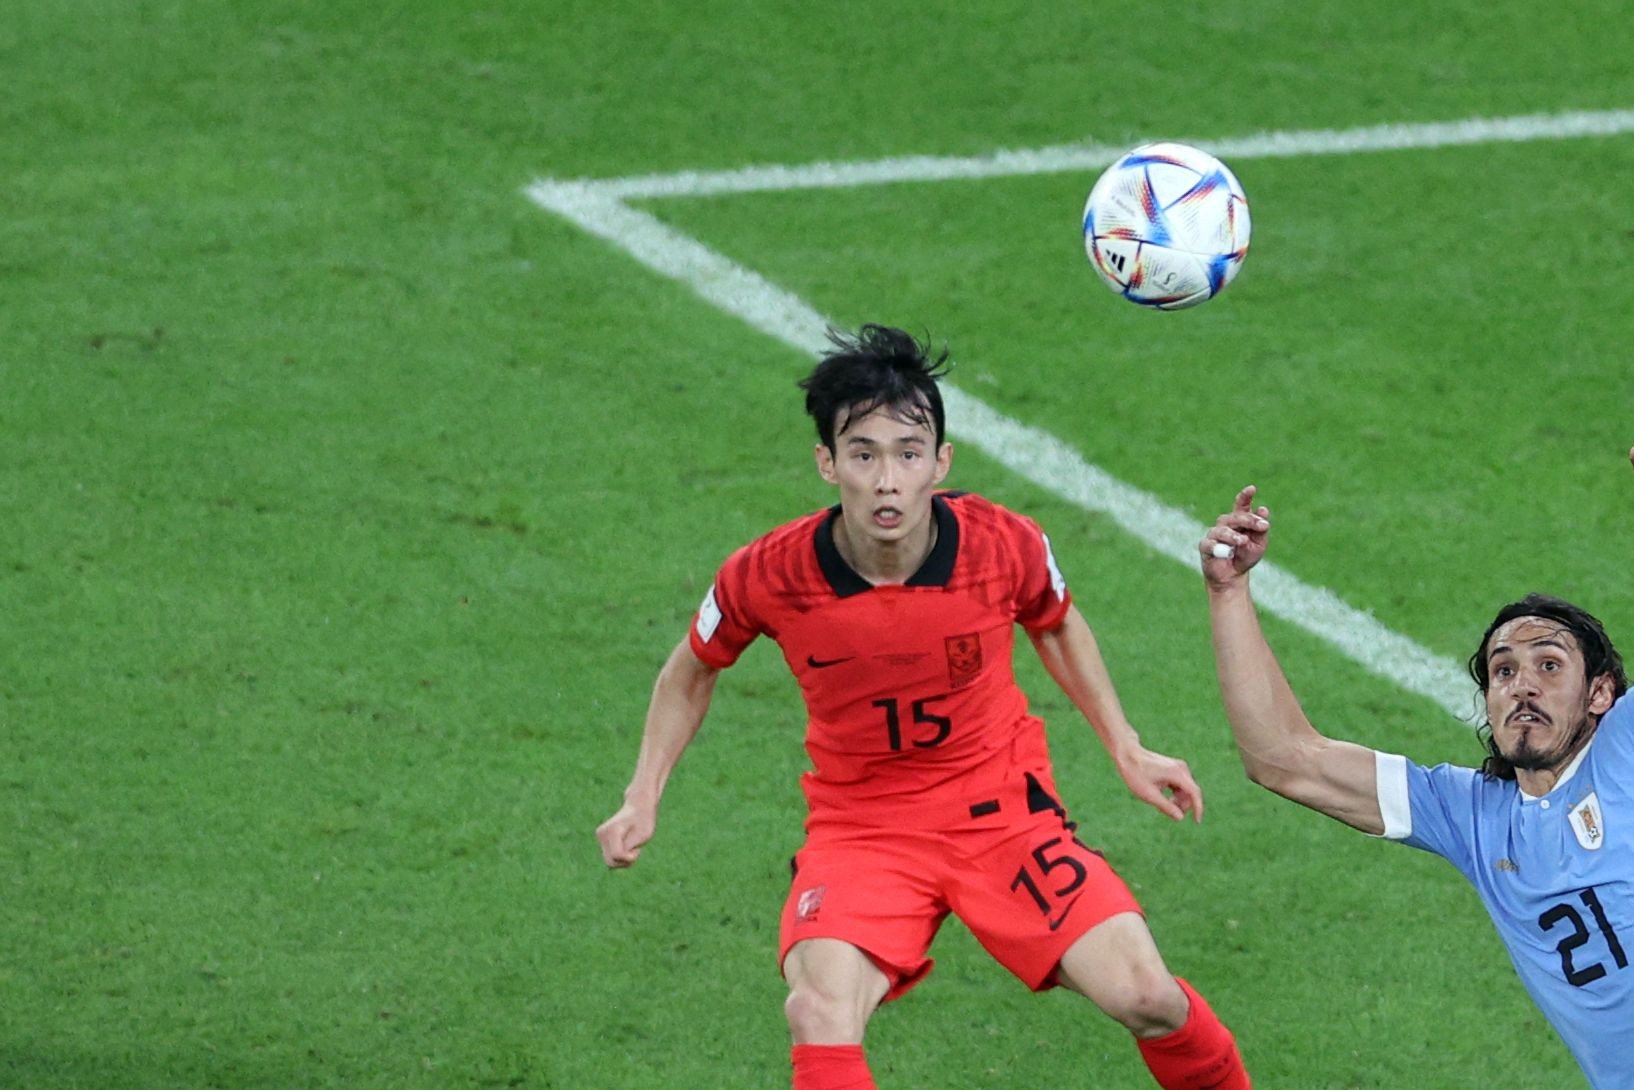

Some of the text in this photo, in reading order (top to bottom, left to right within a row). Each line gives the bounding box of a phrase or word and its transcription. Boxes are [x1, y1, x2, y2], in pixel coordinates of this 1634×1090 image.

[872, 694, 952, 751] 15
[1010, 837, 1087, 916] 15
[1538, 887, 1629, 988] 21
